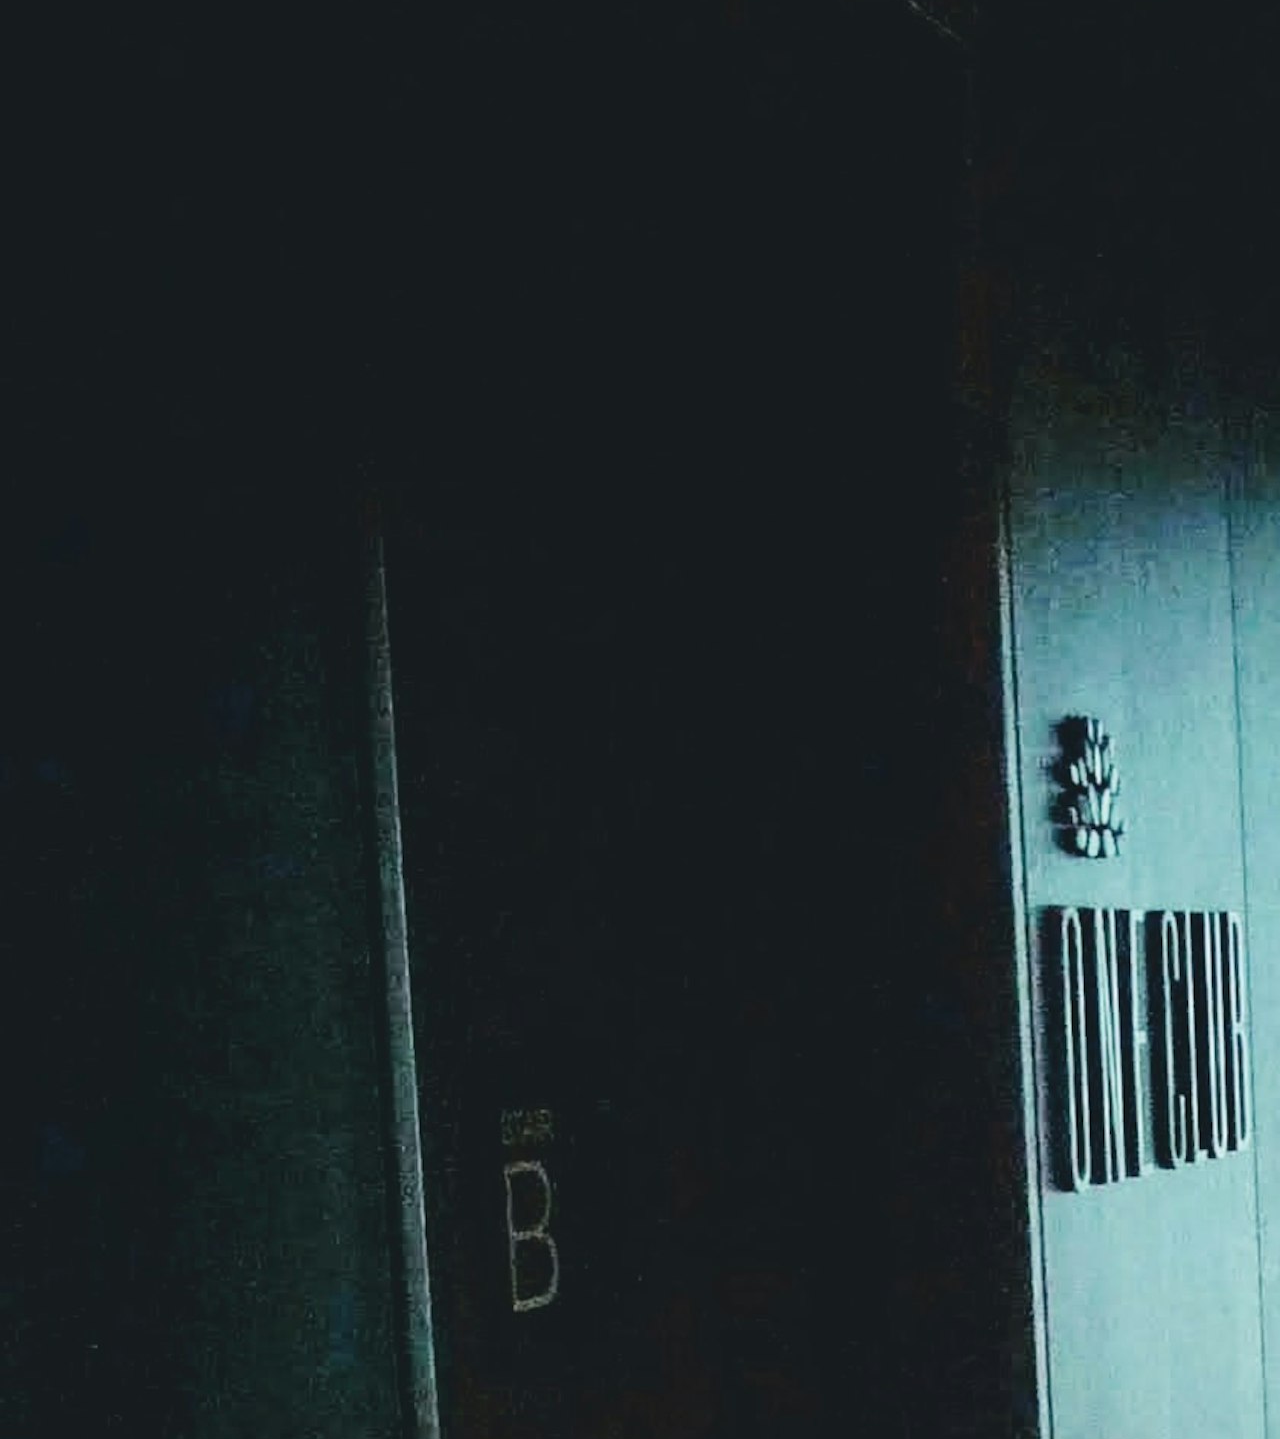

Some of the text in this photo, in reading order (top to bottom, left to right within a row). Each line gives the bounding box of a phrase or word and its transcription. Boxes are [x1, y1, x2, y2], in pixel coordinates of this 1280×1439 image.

[1052, 906, 1250, 1193] ONE CLUB
[503, 1160, 560, 1312] B
